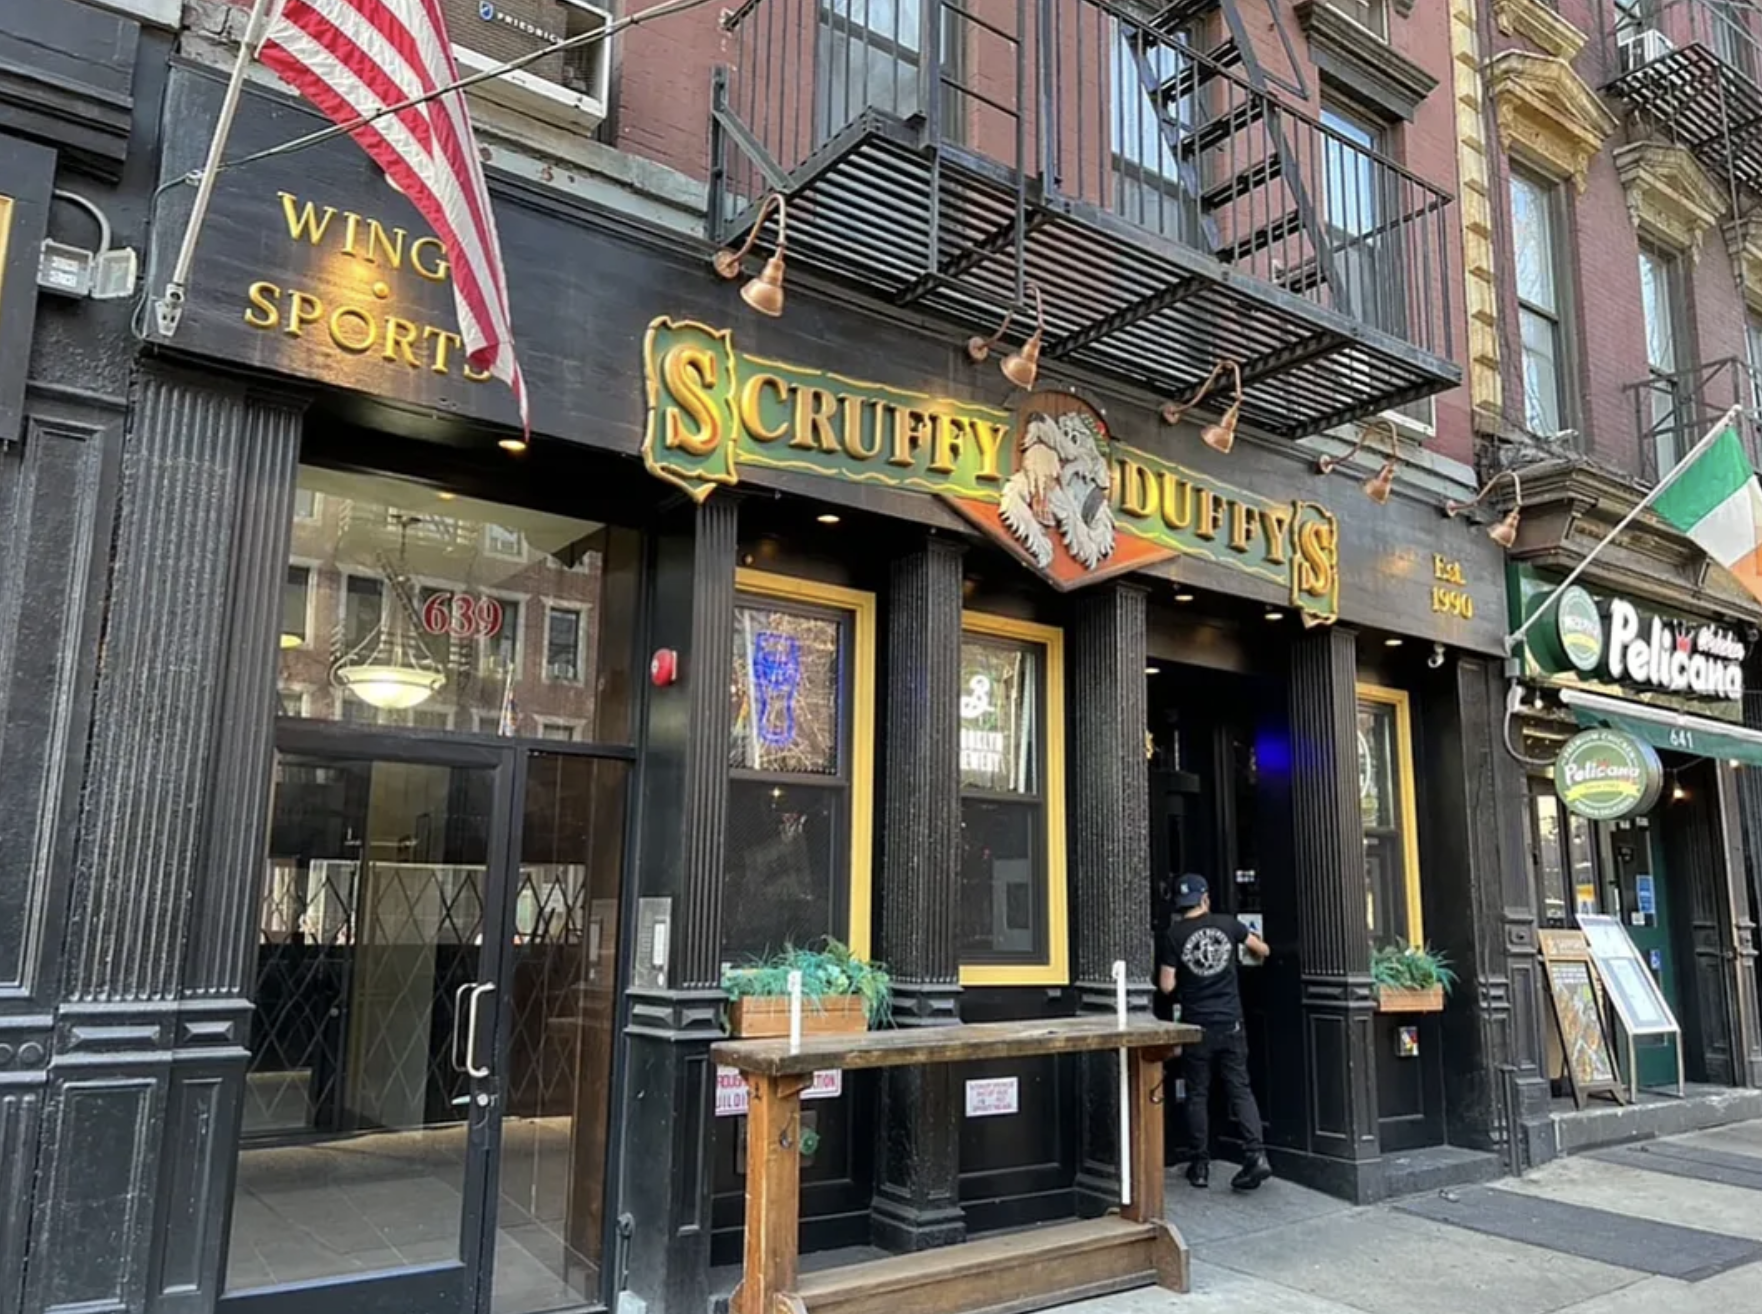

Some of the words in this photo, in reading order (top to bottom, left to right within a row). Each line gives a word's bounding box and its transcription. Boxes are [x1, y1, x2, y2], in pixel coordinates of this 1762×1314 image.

[277, 191, 451, 281] WING
[664, 347, 1010, 480] SCRUFFY
[423, 592, 502, 638] 639
[1432, 586, 1473, 619] 1990
[1608, 598, 1743, 700] Pelicana
[1669, 729, 1694, 748] 641
[1563, 760, 1640, 787] Pelicana
